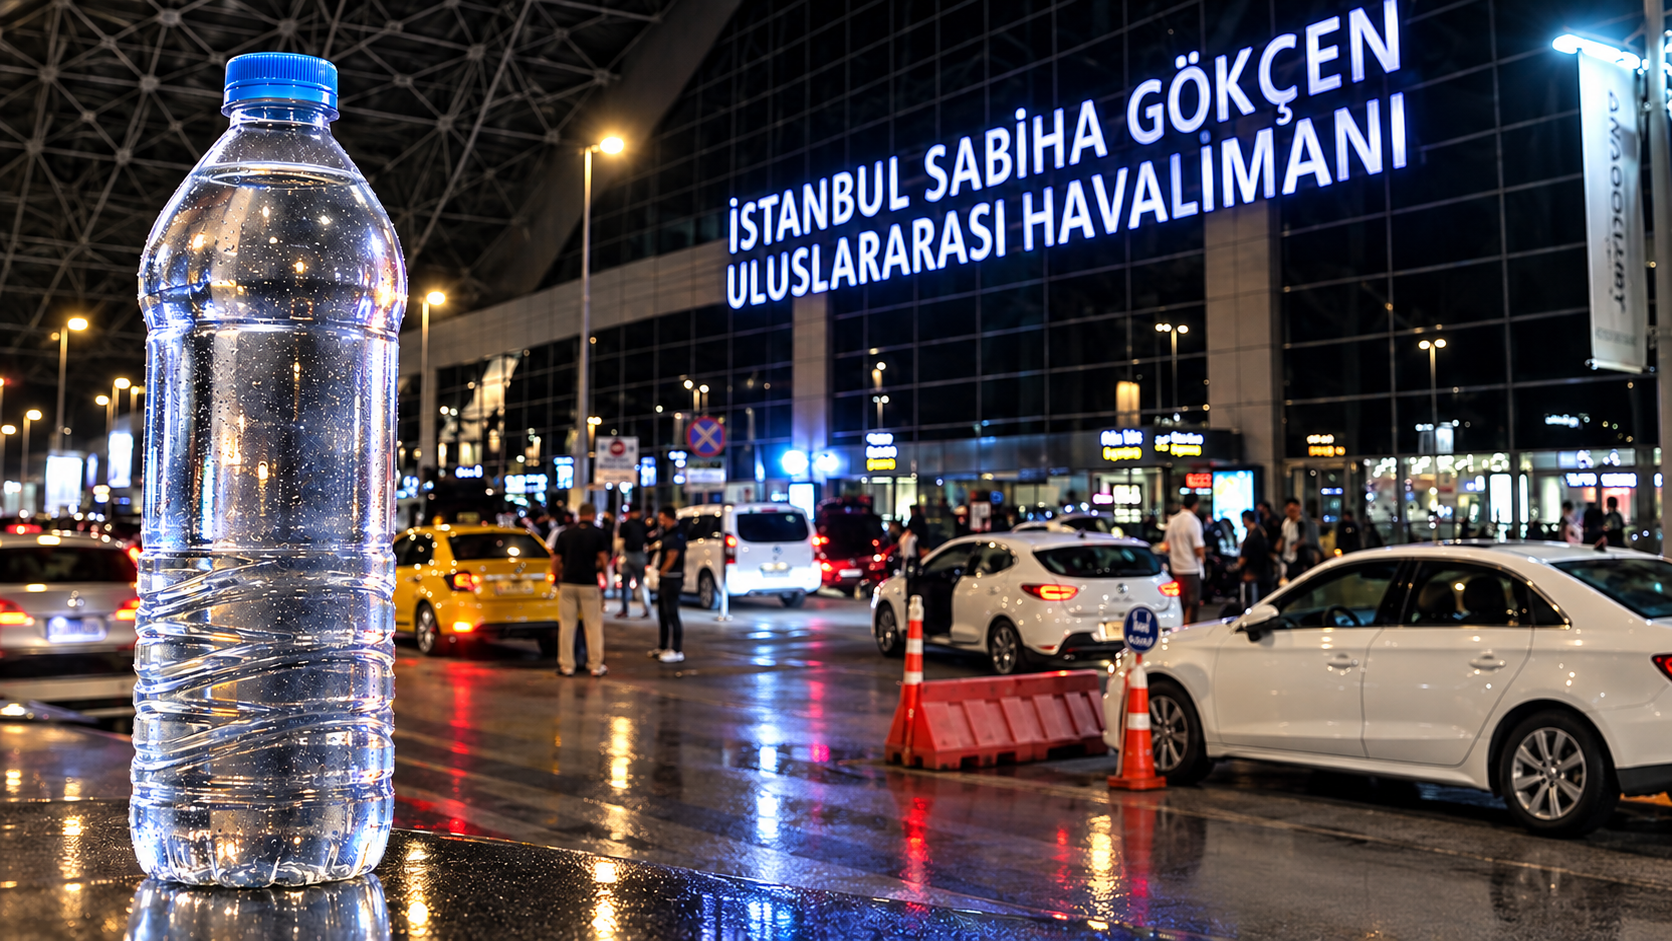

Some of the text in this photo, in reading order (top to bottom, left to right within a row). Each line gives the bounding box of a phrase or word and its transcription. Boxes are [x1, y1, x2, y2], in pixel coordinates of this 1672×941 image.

[727, 92, 1407, 309] ULUSLARARASI HAVALİMANI
[728, 0, 1401, 254] İSTANBUL SABİHA GÖKÇEN
